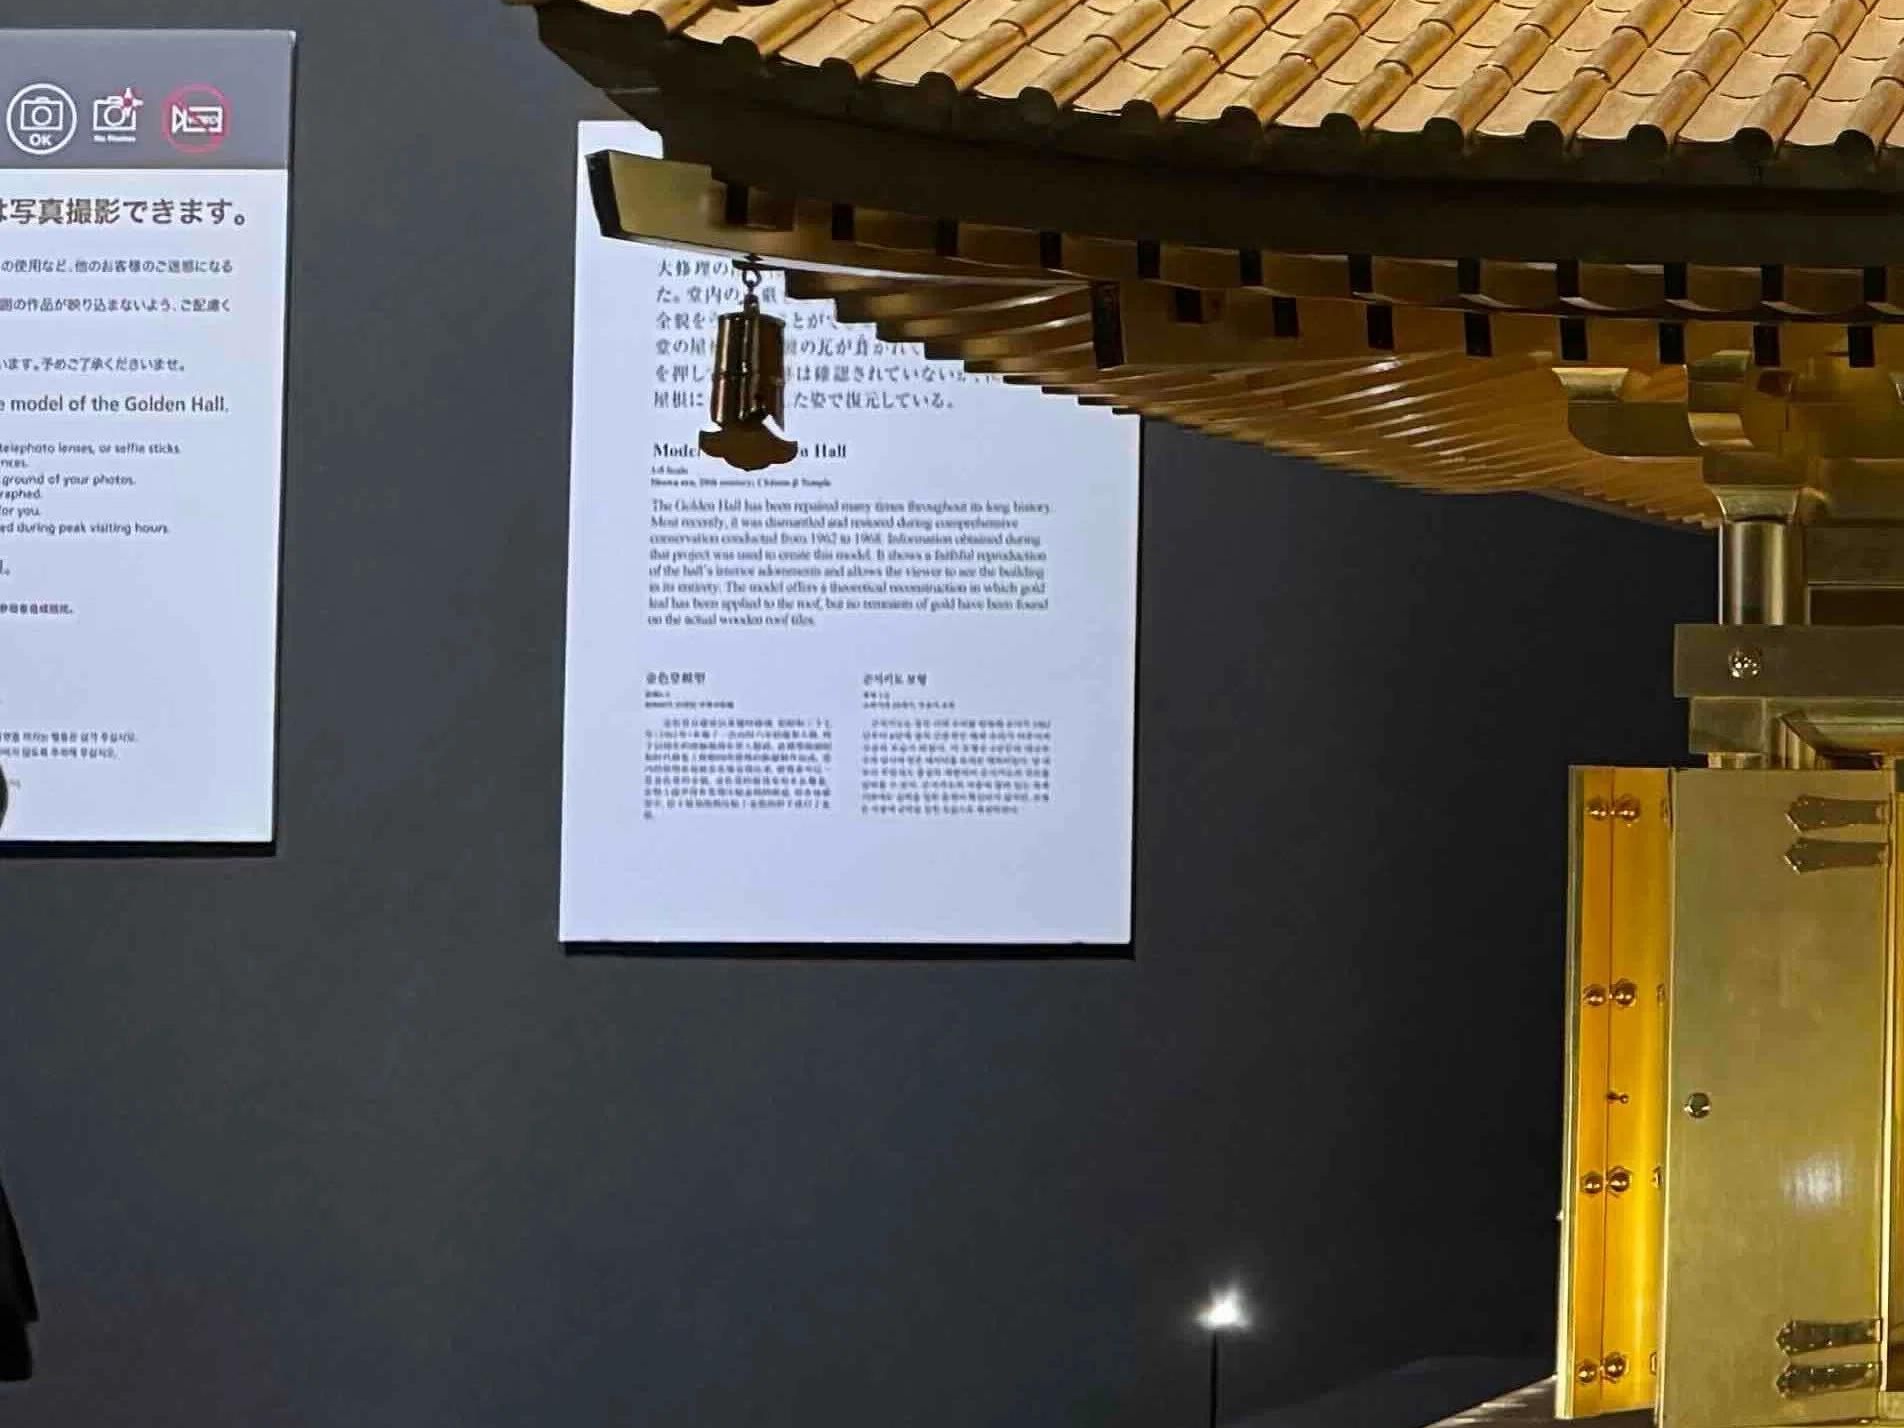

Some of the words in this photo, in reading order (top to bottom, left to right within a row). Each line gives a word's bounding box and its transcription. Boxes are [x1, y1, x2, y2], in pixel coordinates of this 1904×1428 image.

[30, 134, 52, 146] OK
[0, 198, 246, 226] 写真撮影できます。
[10, 395, 63, 412] model
[68, 395, 86, 412] of
[92, 395, 119, 412] the
[125, 395, 186, 412] Golden
[99, 445, 112, 454] or
[115, 441, 145, 454] selfie
[815, 443, 847, 458] Hall
[47, 473, 60, 485] of
[63, 476, 89, 487] your
[653, 498, 672, 512] The
[675, 498, 715, 512] Golden
[718, 498, 741, 512] Hall
[744, 498, 763, 512] has
[765, 498, 791, 512] been
[794, 498, 838, 513] repaired
[841, 501, 871, 513] many
[875, 498, 905, 512] times
[908, 498, 967, 513] throughout
[970, 498, 983, 512] its
[986, 498, 1010, 513] long
[17, 523, 55, 535] during
[59, 523, 86, 535] peak
[90, 523, 131, 535] visiting
[651, 515, 678, 528] Most
[681, 515, 728, 529] recently,
[731, 515, 739, 528] it
[742, 518, 762, 528] was
[765, 515, 825, 528] dismantled
[827, 515, 848, 528] and
[897, 515, 932, 529] during
[650, 532, 719, 544] conservation
[721, 532, 777, 544] conducted
[781, 532, 808, 544] from
[812, 532, 836, 544] 1962
[840, 532, 851, 544] to
[888, 532, 952, 544] Information
[955, 532, 1003, 544] obtained
[1006, 532, 1041, 545] during
[650, 548, 670, 561] that
[672, 548, 710, 562] project
[713, 551, 735, 561] was
[737, 548, 762, 561] used
[765, 548, 776, 561] to
[778, 548, 811, 561] create
[814, 548, 833, 561] this
[876, 548, 885, 561] It
[888, 548, 922, 561] shows
[925, 551, 931, 561] a
[976, 548, 1047, 562] reproduction
[650, 564, 661, 577] of
[663, 564, 680, 577] the
[682, 564, 713, 577] hall's
[824, 564, 845, 577] and
[847, 564, 882, 577] allows
[885, 564, 902, 577] the
[905, 564, 942, 577] viewer
[945, 564, 957, 577] to
[958, 567, 976, 577] see
[979, 564, 997, 577] the
[999, 564, 1045, 578] building
[649, 580, 660, 593] in
[662, 580, 675, 593] its
[678, 580, 722, 594] entirety.
[726, 580, 745, 593] The
[749, 580, 783, 593] model
[786, 580, 818, 593] offers
[820, 583, 827, 593] a
[830, 580, 887, 593] theoretical
[889, 580, 967, 593] reconstruction
[970, 580, 981, 593] in
[983, 580, 1017, 593] which
[1020, 580, 1046, 594] gold
[649, 596, 668, 609] leaf
[671, 596, 691, 609] has
[693, 596, 719, 609] been
[721, 596, 761, 610] applied
[764, 596, 775, 609] to
[777, 596, 794, 609] the
[797, 596, 824, 610] roof,
[826, 596, 845, 609] but
[847, 599, 860, 609] no
[915, 596, 929, 609] of
[931, 596, 955, 610] gold
[958, 596, 984, 609] have
[987, 596, 1013, 609] been
[1016, 596, 1049, 609] found
[648, 616, 662, 625] on
[665, 613, 681, 625] the
[684, 613, 717, 625] actual
[719, 613, 763, 625] wooden
[765, 613, 788, 625] roof
[791, 613, 816, 625] tiles.
